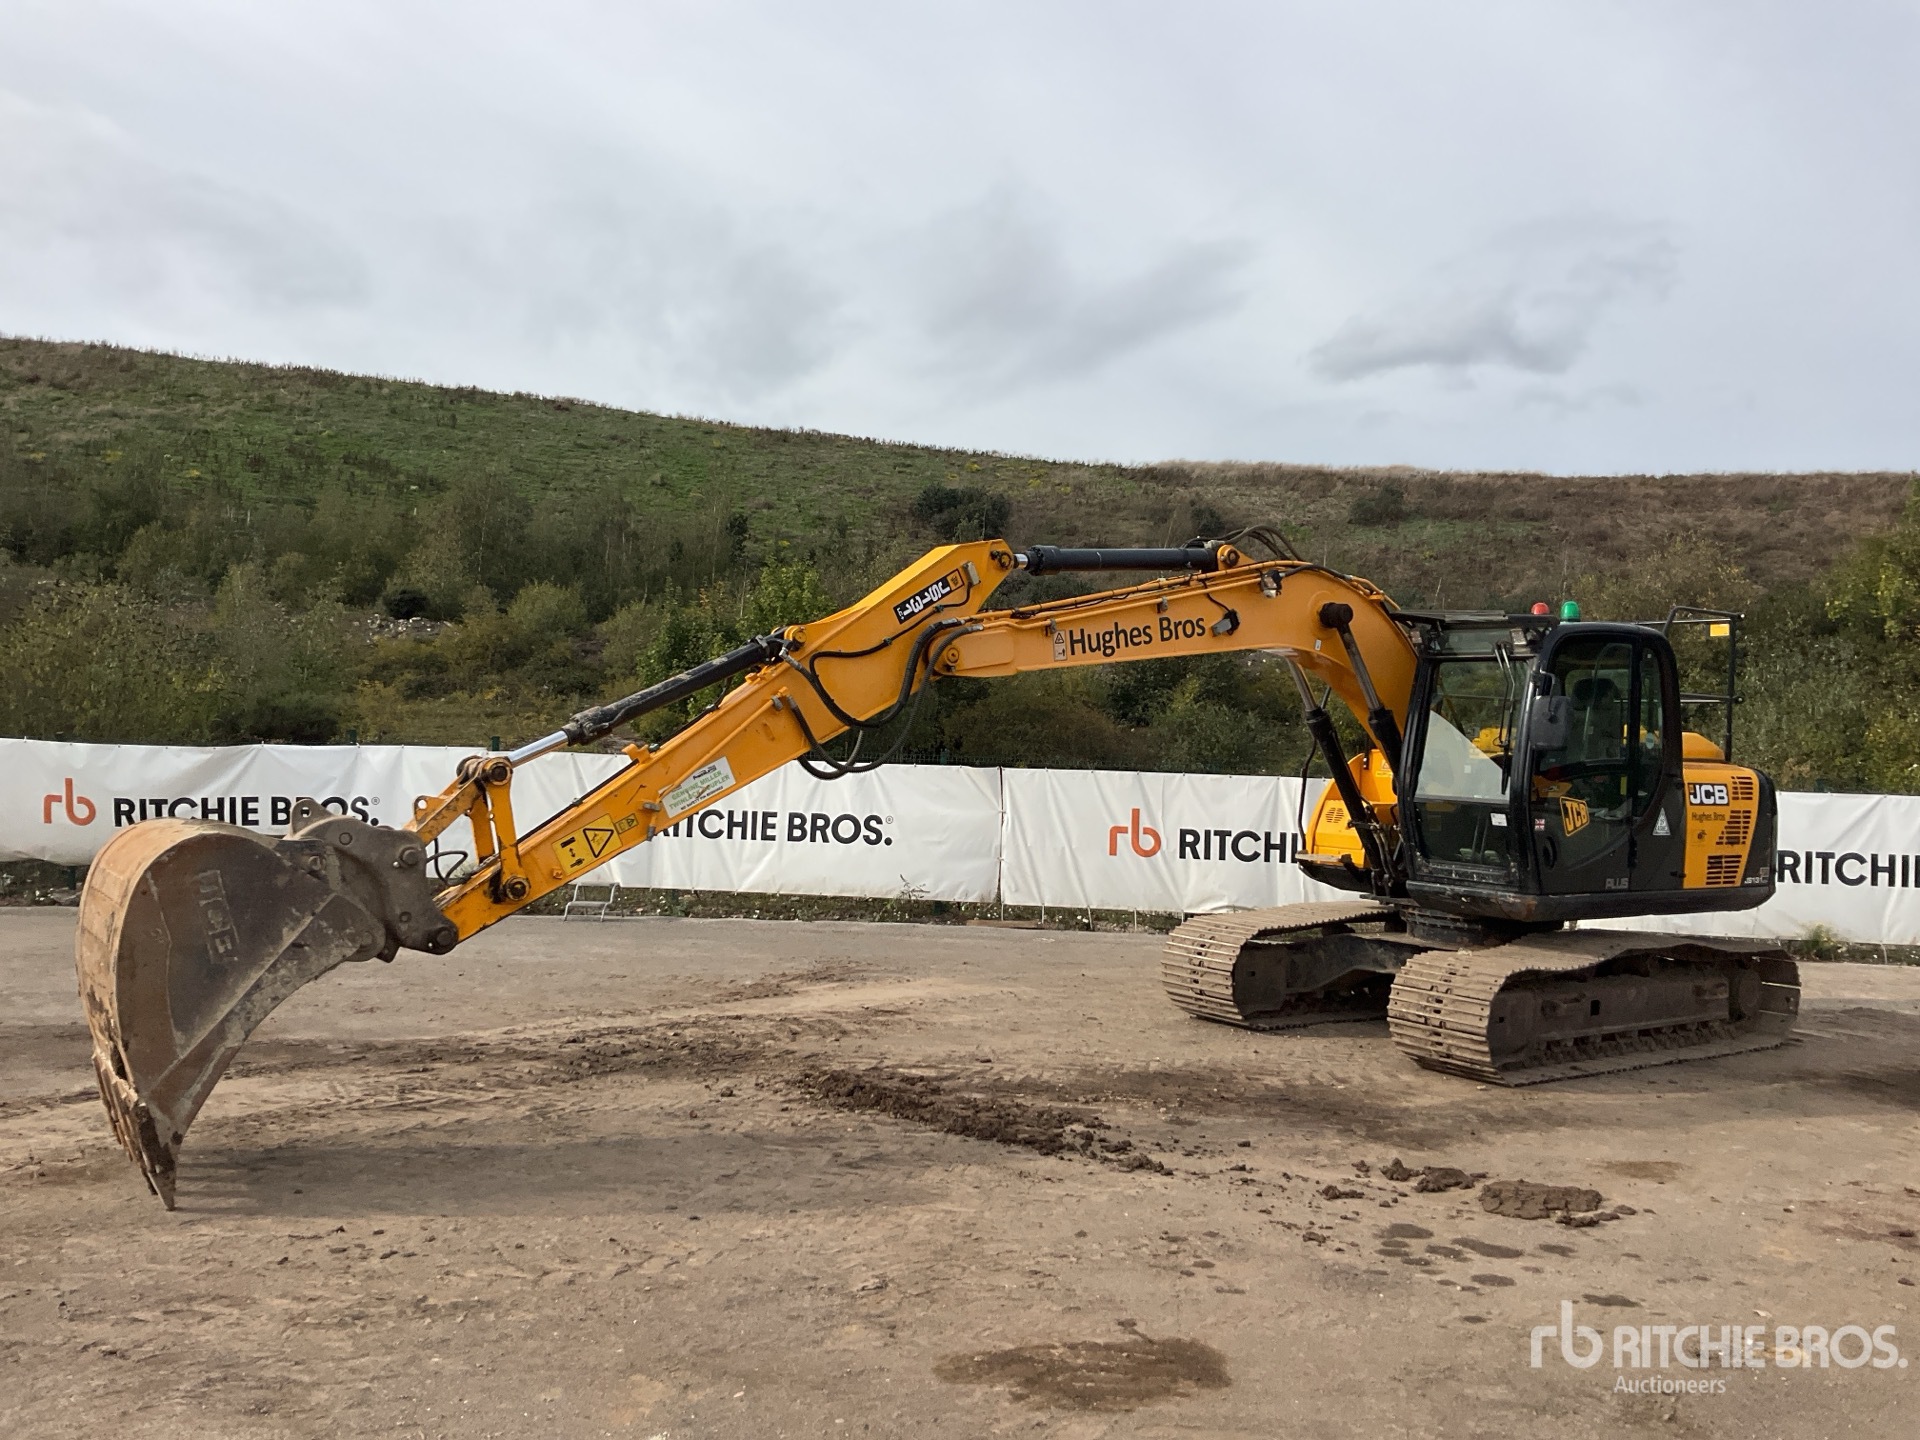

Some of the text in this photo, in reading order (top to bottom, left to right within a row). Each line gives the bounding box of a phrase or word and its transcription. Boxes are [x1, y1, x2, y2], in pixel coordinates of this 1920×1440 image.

[1069, 616, 1206, 657] Hughes Bros
[43, 778, 97, 826] rb
[1689, 784, 1728, 804] JCB
[114, 796, 260, 827] RITCHIE
[662, 808, 778, 841] ITCHIE
[1564, 800, 1588, 832] JCB
[1713, 811, 1726, 821] Bros
[1109, 808, 1162, 858] rb
[1179, 827, 1298, 864] RITCHI
